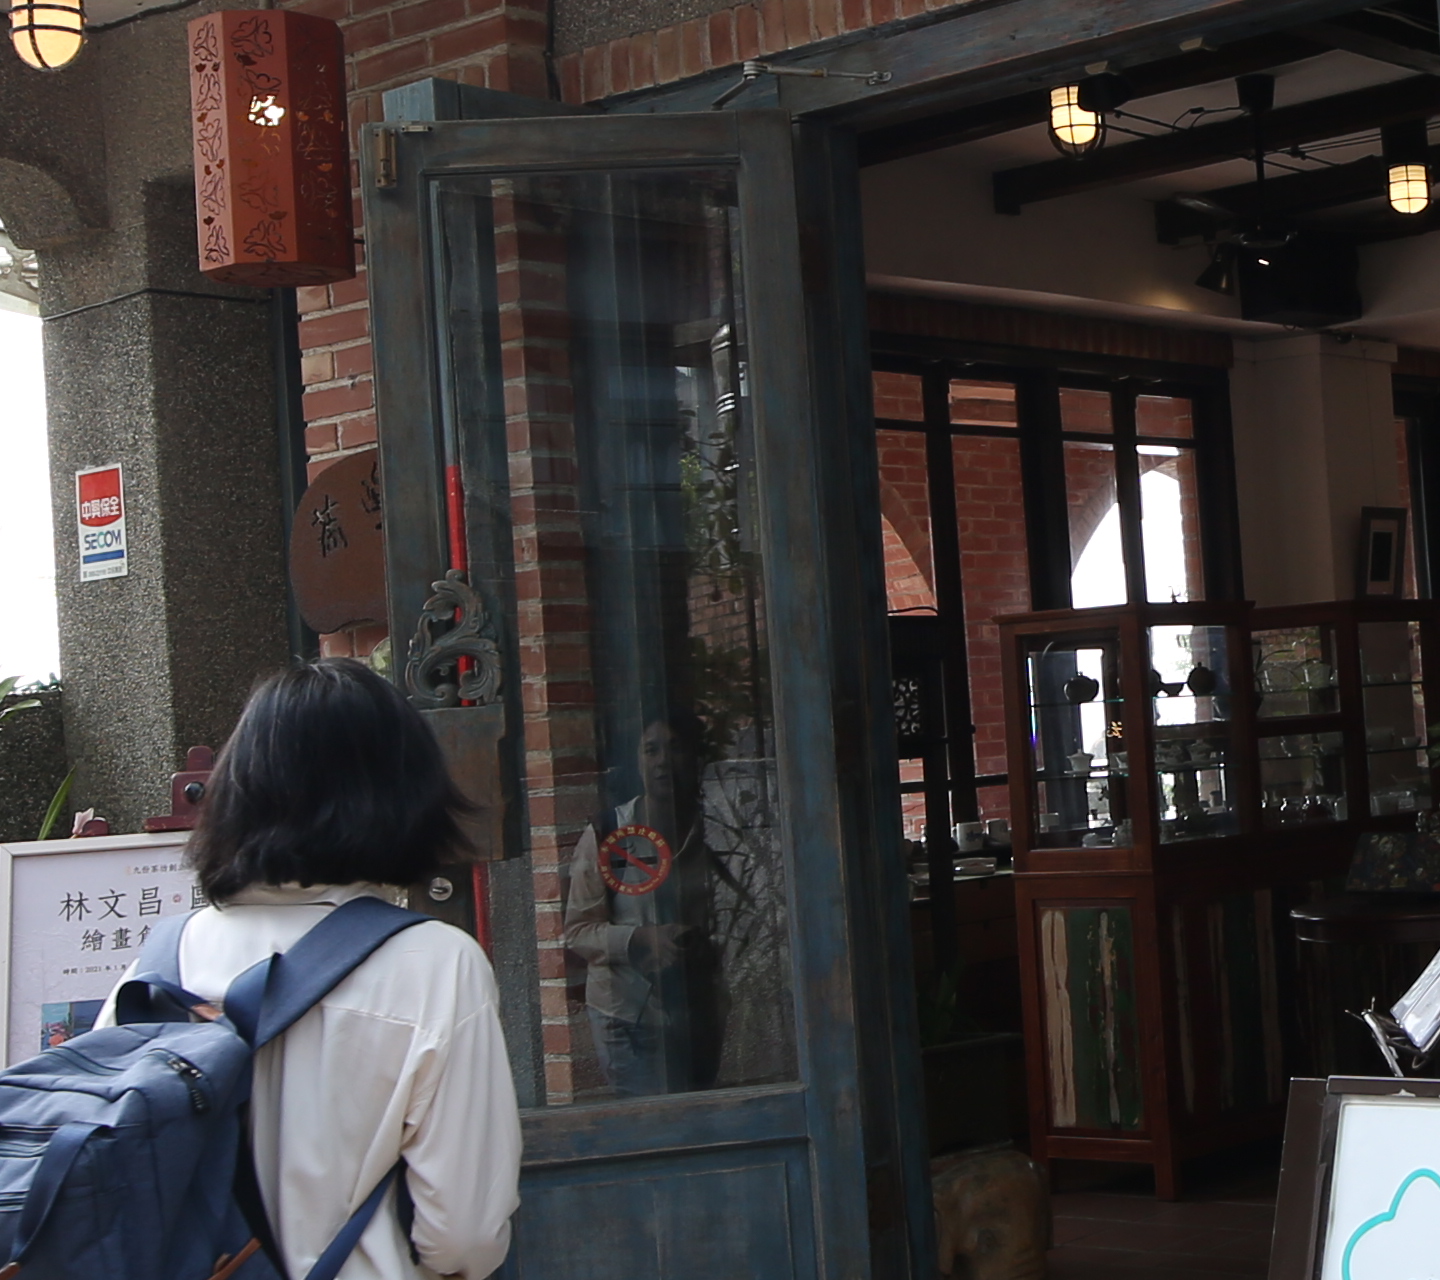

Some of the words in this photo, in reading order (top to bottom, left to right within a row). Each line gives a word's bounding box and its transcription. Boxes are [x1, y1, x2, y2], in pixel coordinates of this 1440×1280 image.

[81, 496, 120, 520] 中興保全
[84, 529, 122, 551] SECOM
[57, 886, 163, 922] 林文昌
